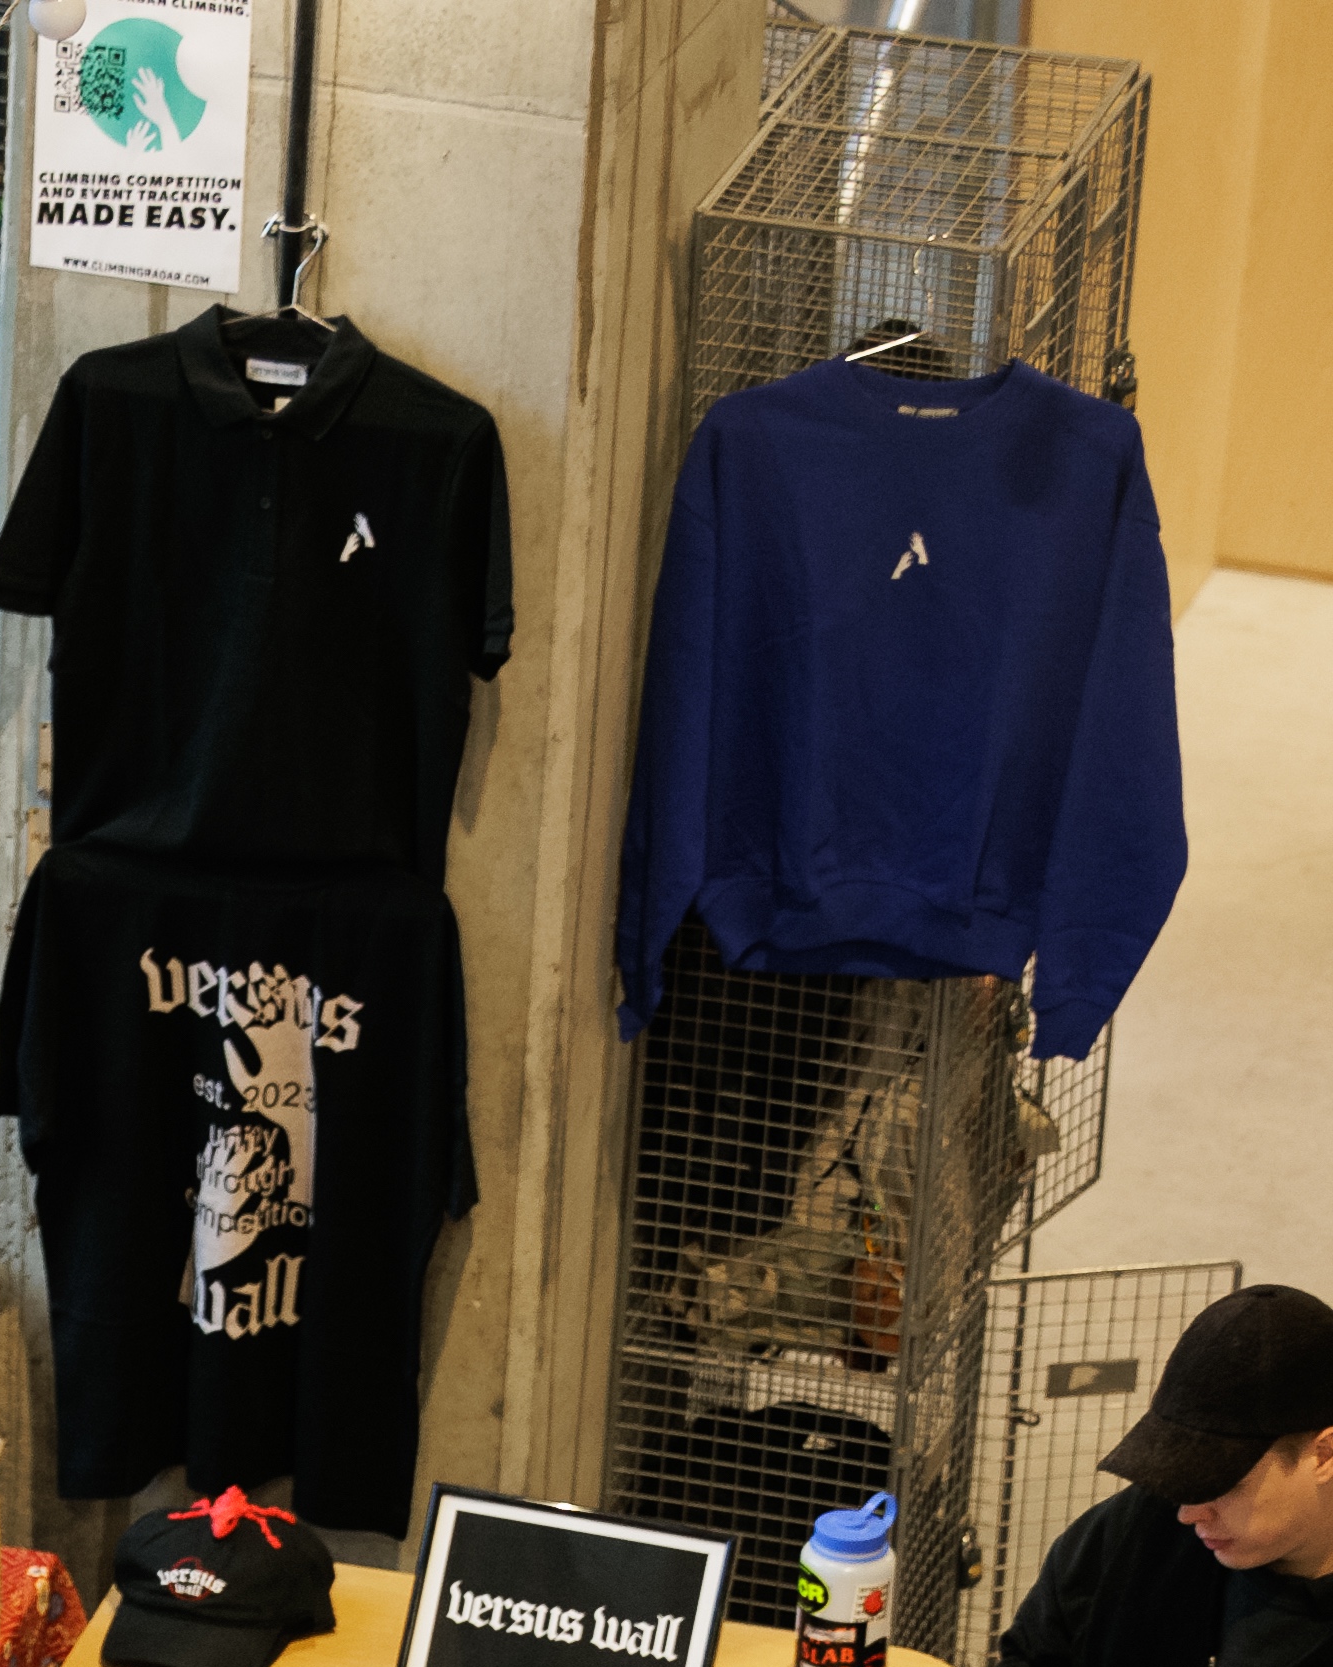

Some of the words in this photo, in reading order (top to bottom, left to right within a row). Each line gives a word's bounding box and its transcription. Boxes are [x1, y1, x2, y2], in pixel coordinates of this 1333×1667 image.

[39, 172, 121, 186] CLIMBING
[127, 175, 241, 190] COMPETITION
[40, 187, 75, 199] AND
[80, 188, 133, 201] EVENT
[139, 190, 223, 203] TRACKING
[36, 202, 135, 226] MADE
[146, 205, 236, 231] EASY.
[193, 1073, 231, 1110] est.
[241, 1081, 315, 1113] 2023
[446, 1580, 585, 1644] versus
[589, 1606, 685, 1663] wall
